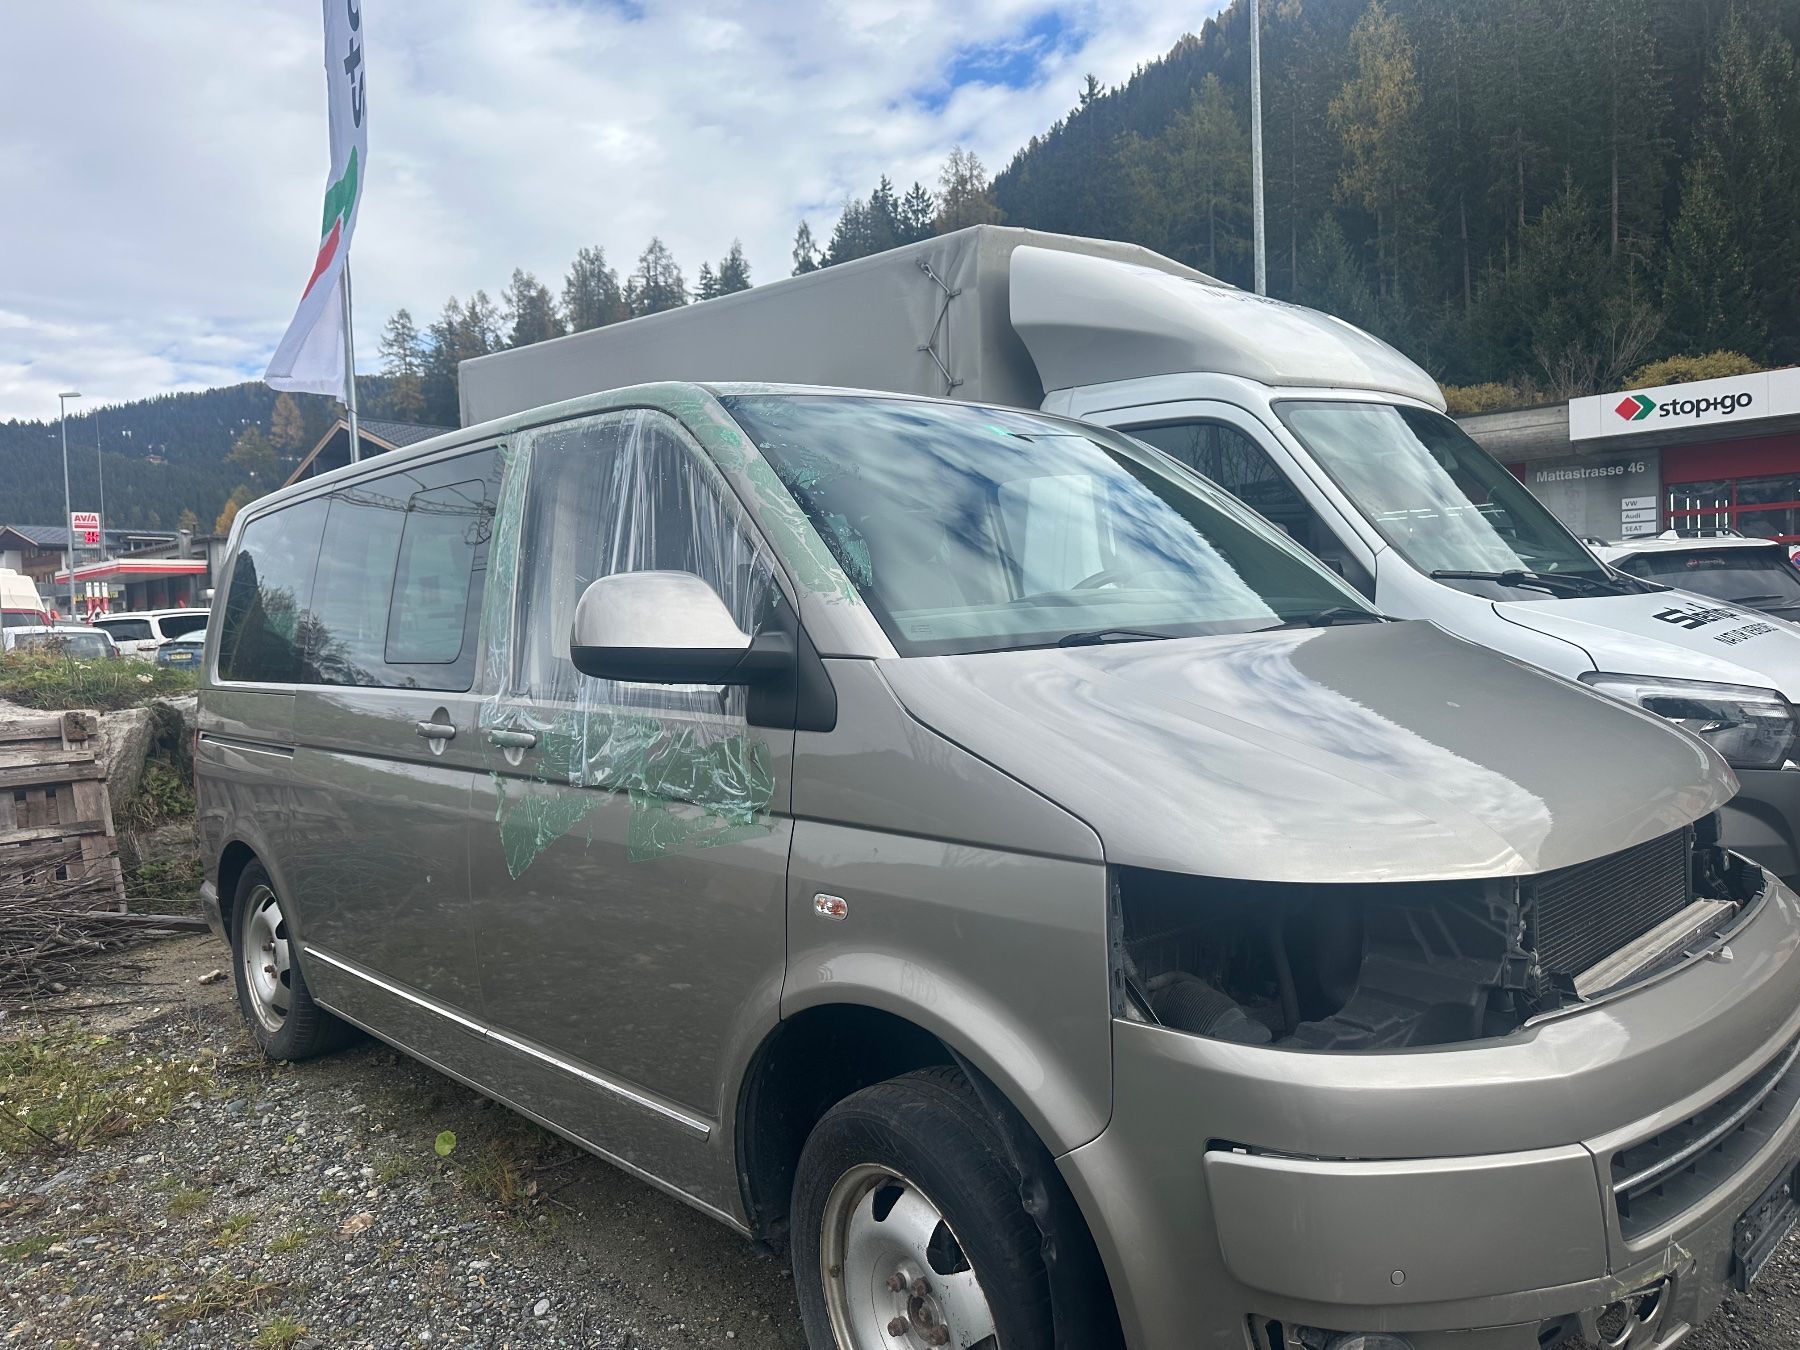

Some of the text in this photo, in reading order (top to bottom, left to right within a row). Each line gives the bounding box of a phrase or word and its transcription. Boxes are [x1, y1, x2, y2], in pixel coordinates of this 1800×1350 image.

[1659, 392, 1753, 418] stop+go
[1536, 461, 1645, 483] Mattastrasse 46
[74, 514, 97, 522] AVIA
